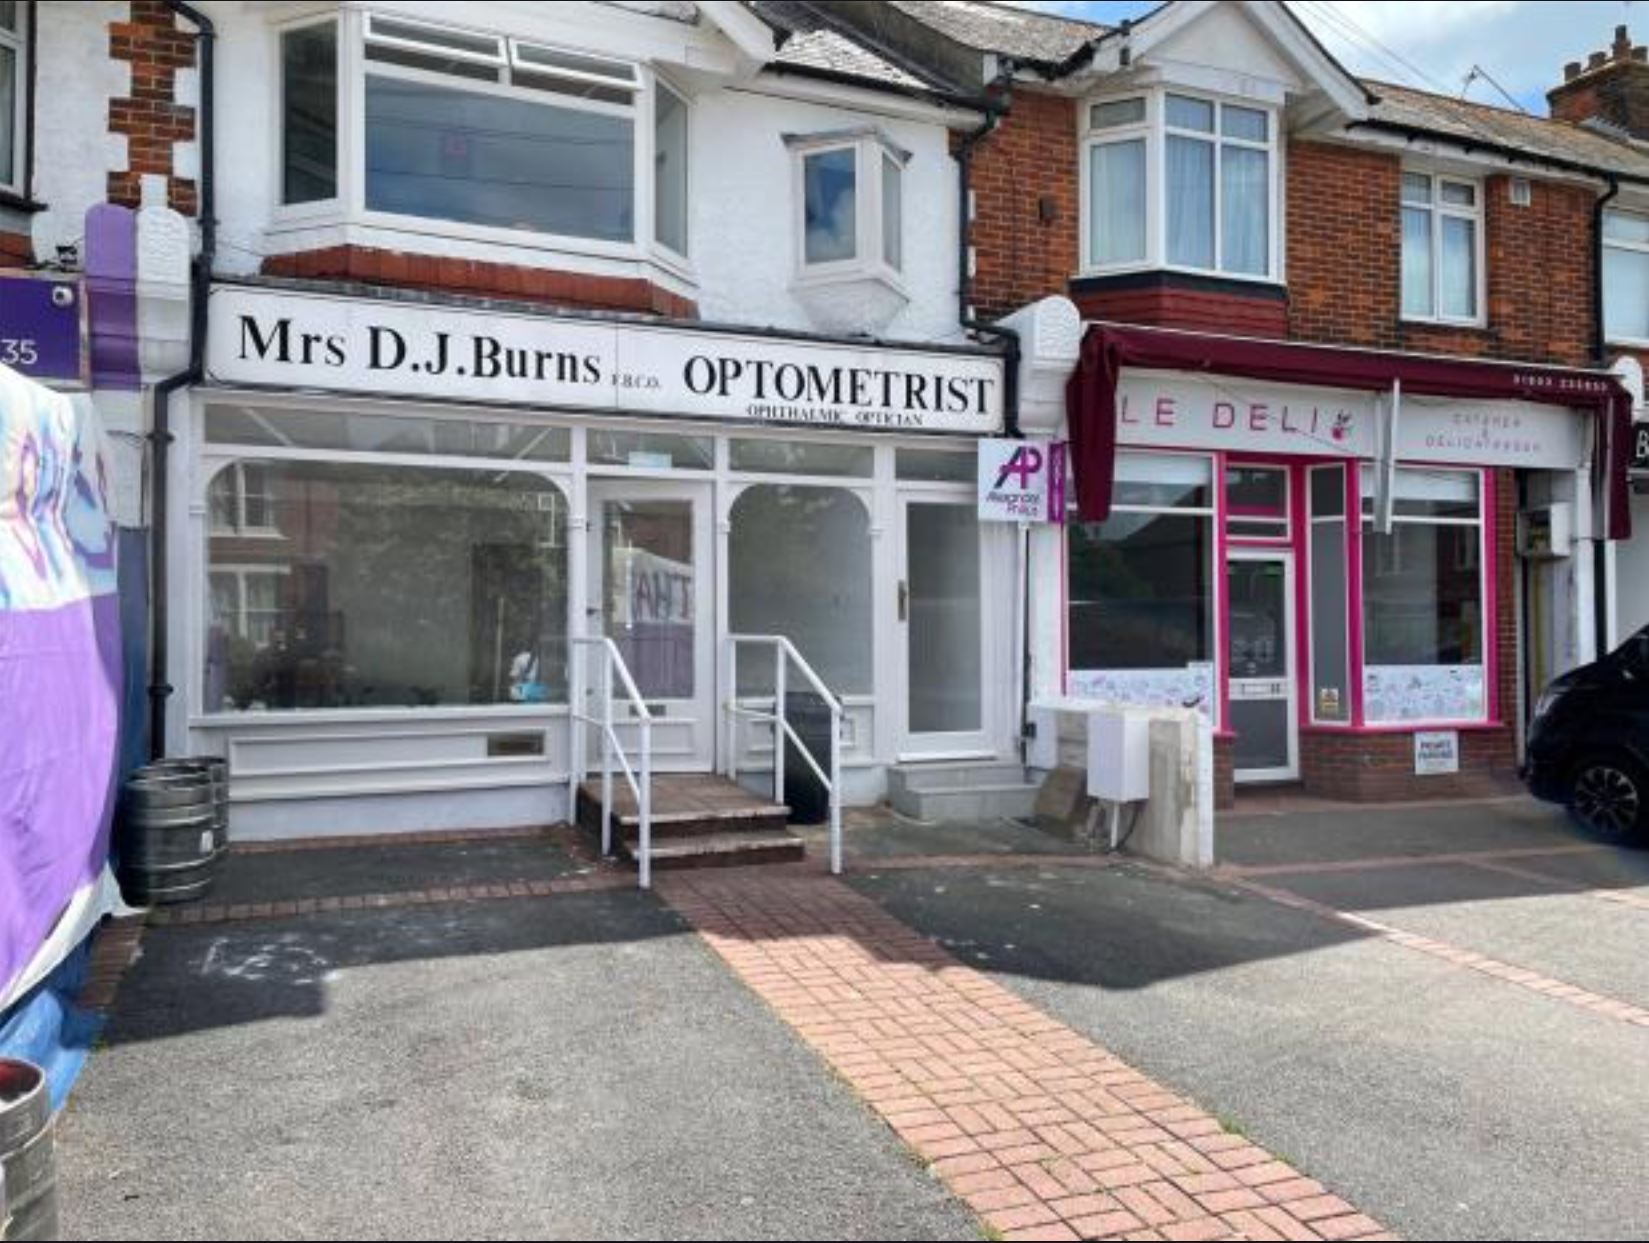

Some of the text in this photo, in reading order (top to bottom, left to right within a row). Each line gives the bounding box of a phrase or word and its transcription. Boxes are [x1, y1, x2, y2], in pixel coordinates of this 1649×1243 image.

[239, 315, 346, 368] Mrs
[367, 325, 600, 386] D.J.Burns
[684, 355, 995, 414] OPTOMETRIST
[855, 411, 923, 426] OPTICIAN
[1121, 395, 1318, 434] LE DELI
